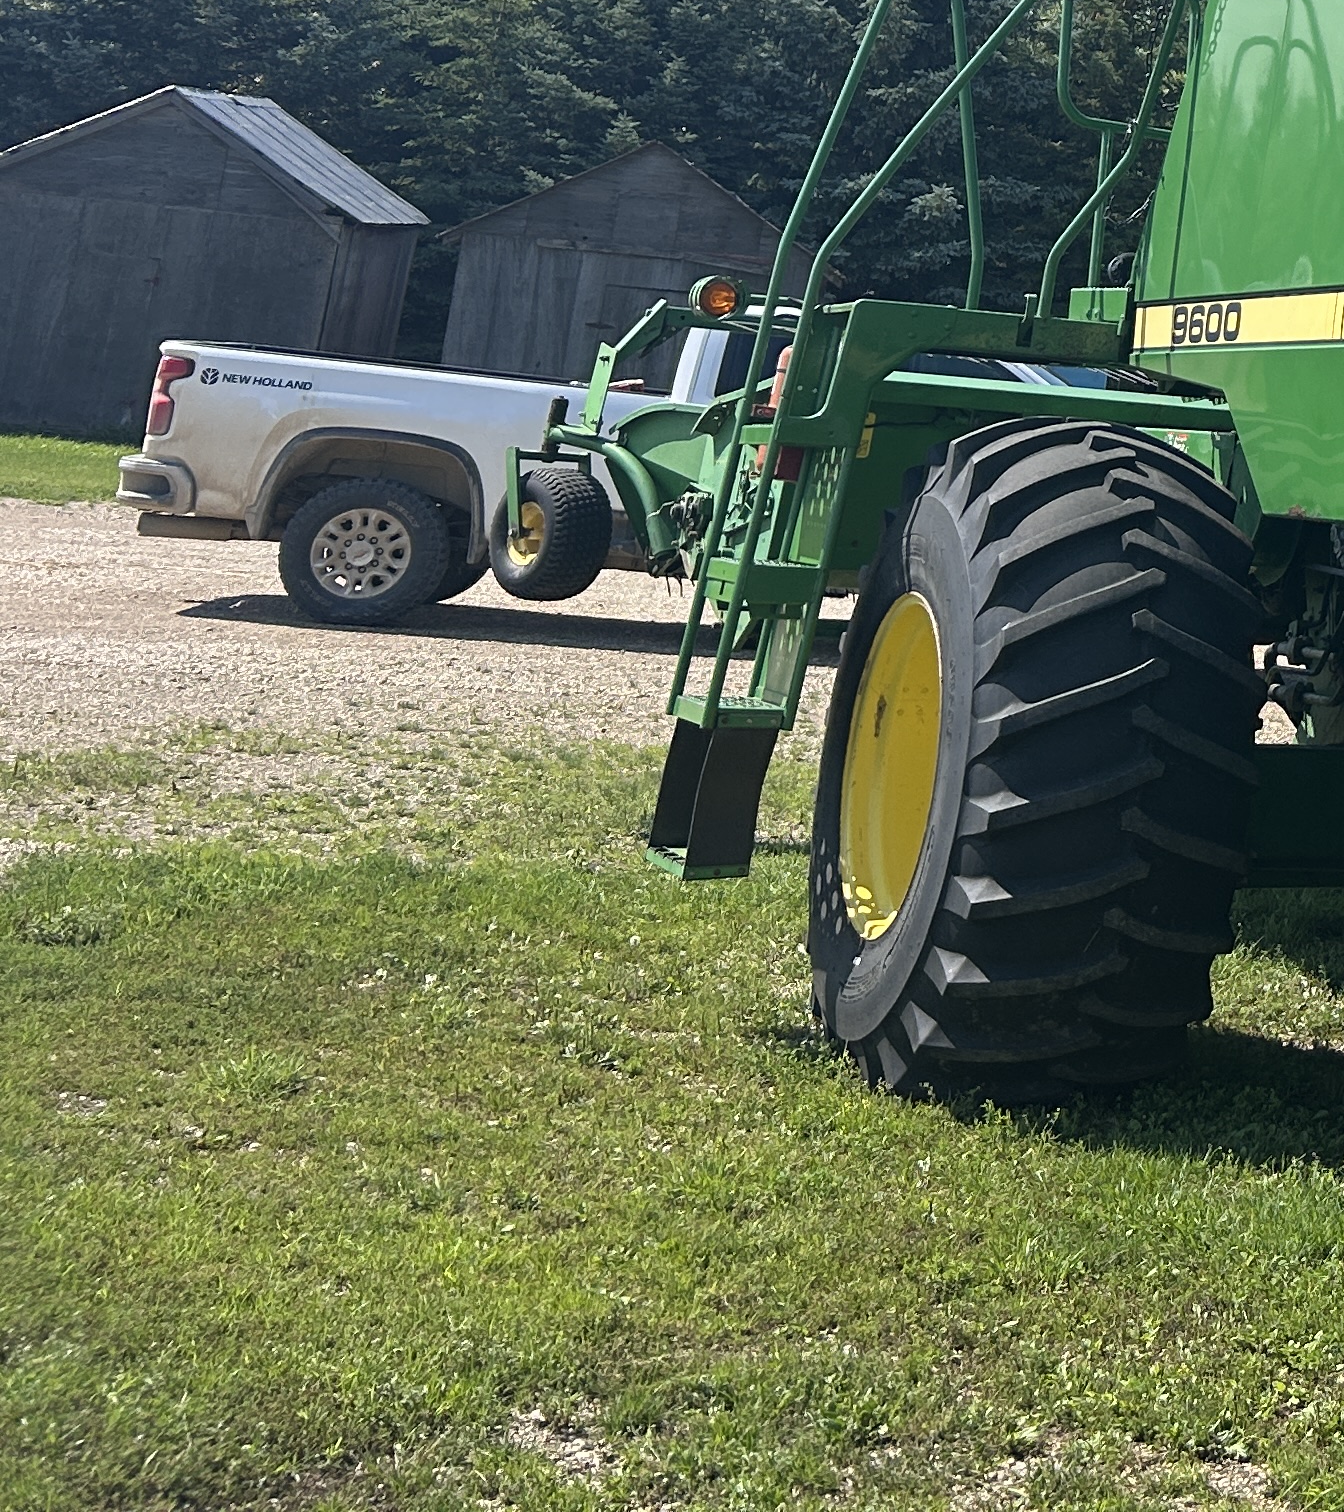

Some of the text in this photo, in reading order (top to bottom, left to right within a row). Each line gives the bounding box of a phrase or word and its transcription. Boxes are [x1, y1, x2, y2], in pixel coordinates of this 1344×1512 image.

[1172, 302, 1241, 345] 9600
[222, 373, 313, 391] NEW HOLLAND
